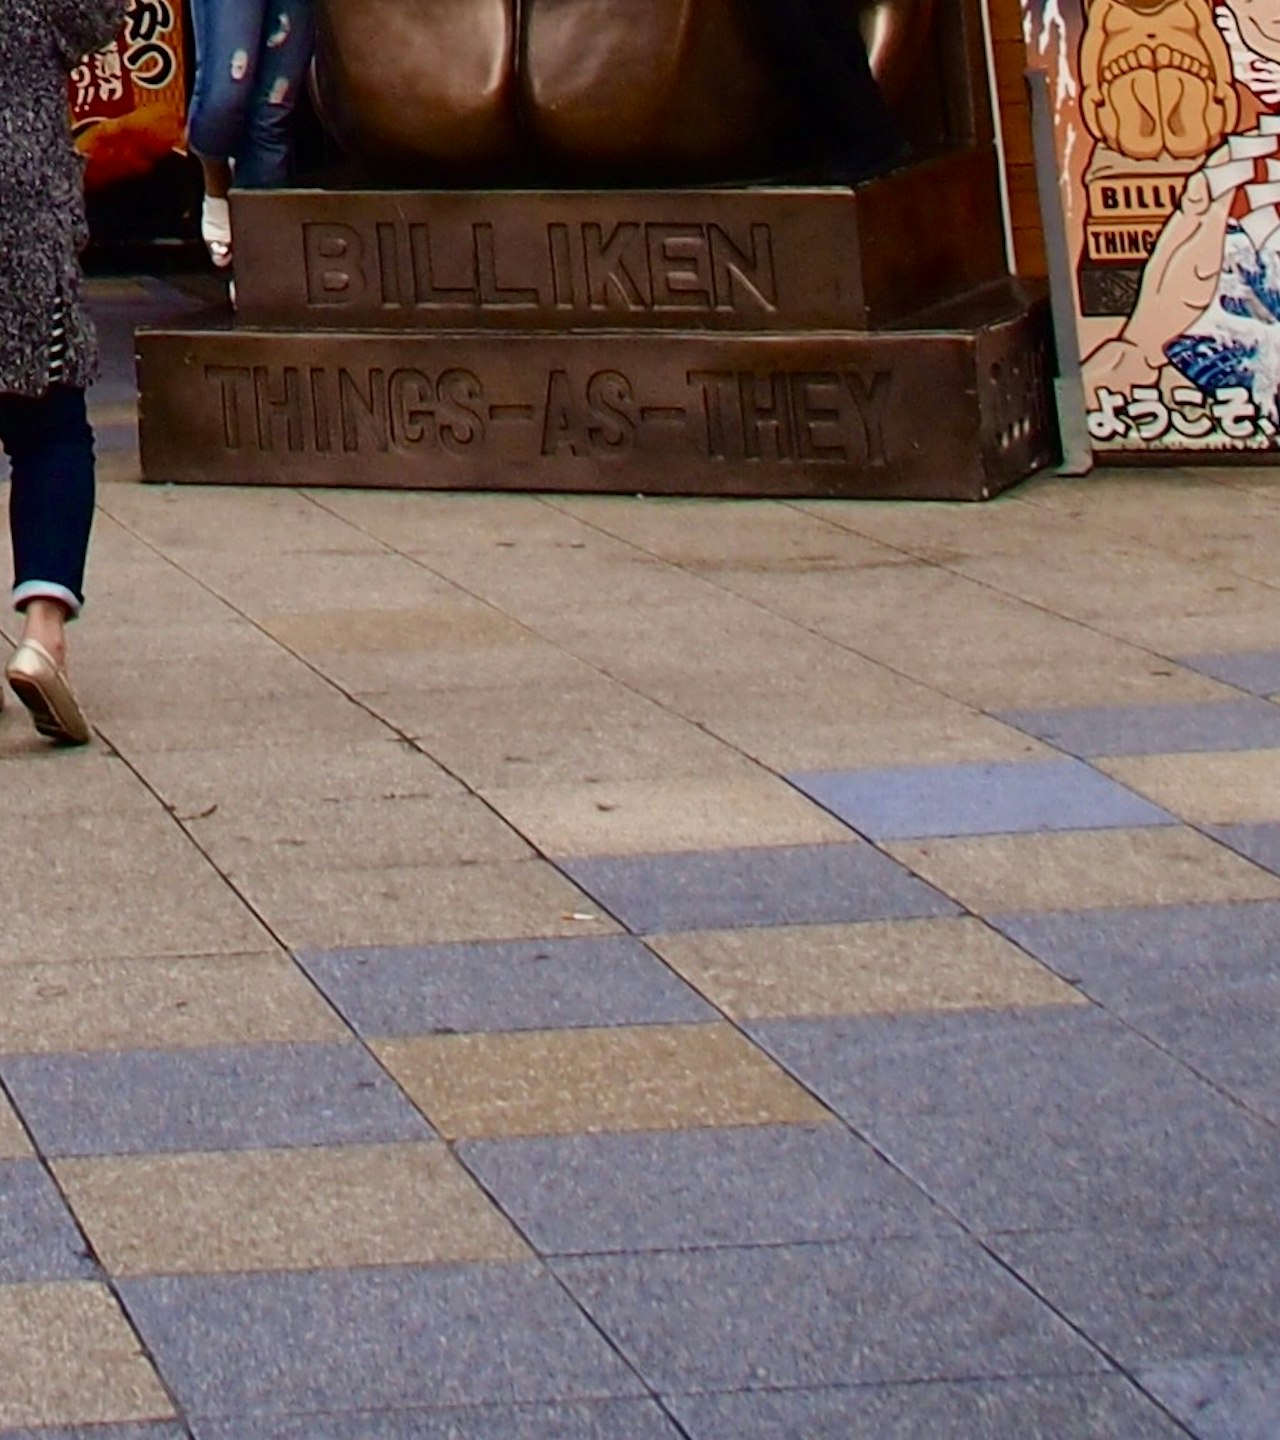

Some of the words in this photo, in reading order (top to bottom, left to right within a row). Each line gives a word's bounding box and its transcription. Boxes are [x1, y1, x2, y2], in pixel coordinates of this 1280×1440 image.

[302, 221, 778, 311] BILLIKEN
[1092, 231, 1158, 254] THING
[206, 366, 893, 464] THINGS-AS-THEY
